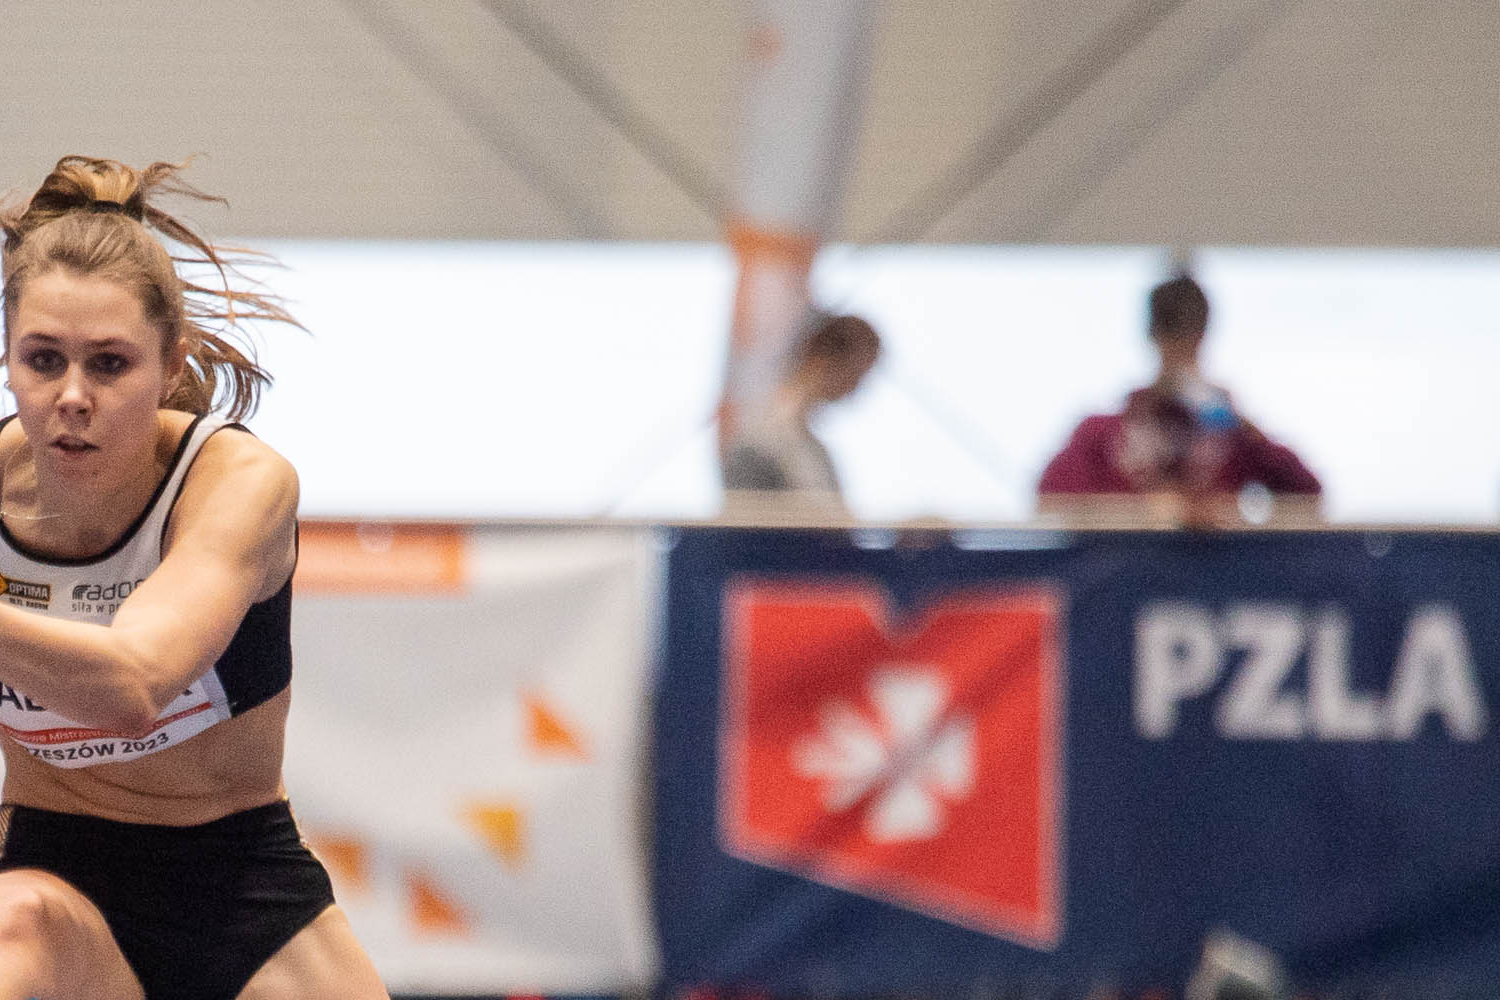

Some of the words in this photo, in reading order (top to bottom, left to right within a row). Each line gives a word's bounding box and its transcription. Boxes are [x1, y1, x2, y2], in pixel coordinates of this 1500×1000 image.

[8, 582, 49, 600] OPTIMA
[1133, 603, 1484, 743] PZLA
[25, 742, 115, 762] ZESZÓW
[121, 731, 169, 754] 2023
